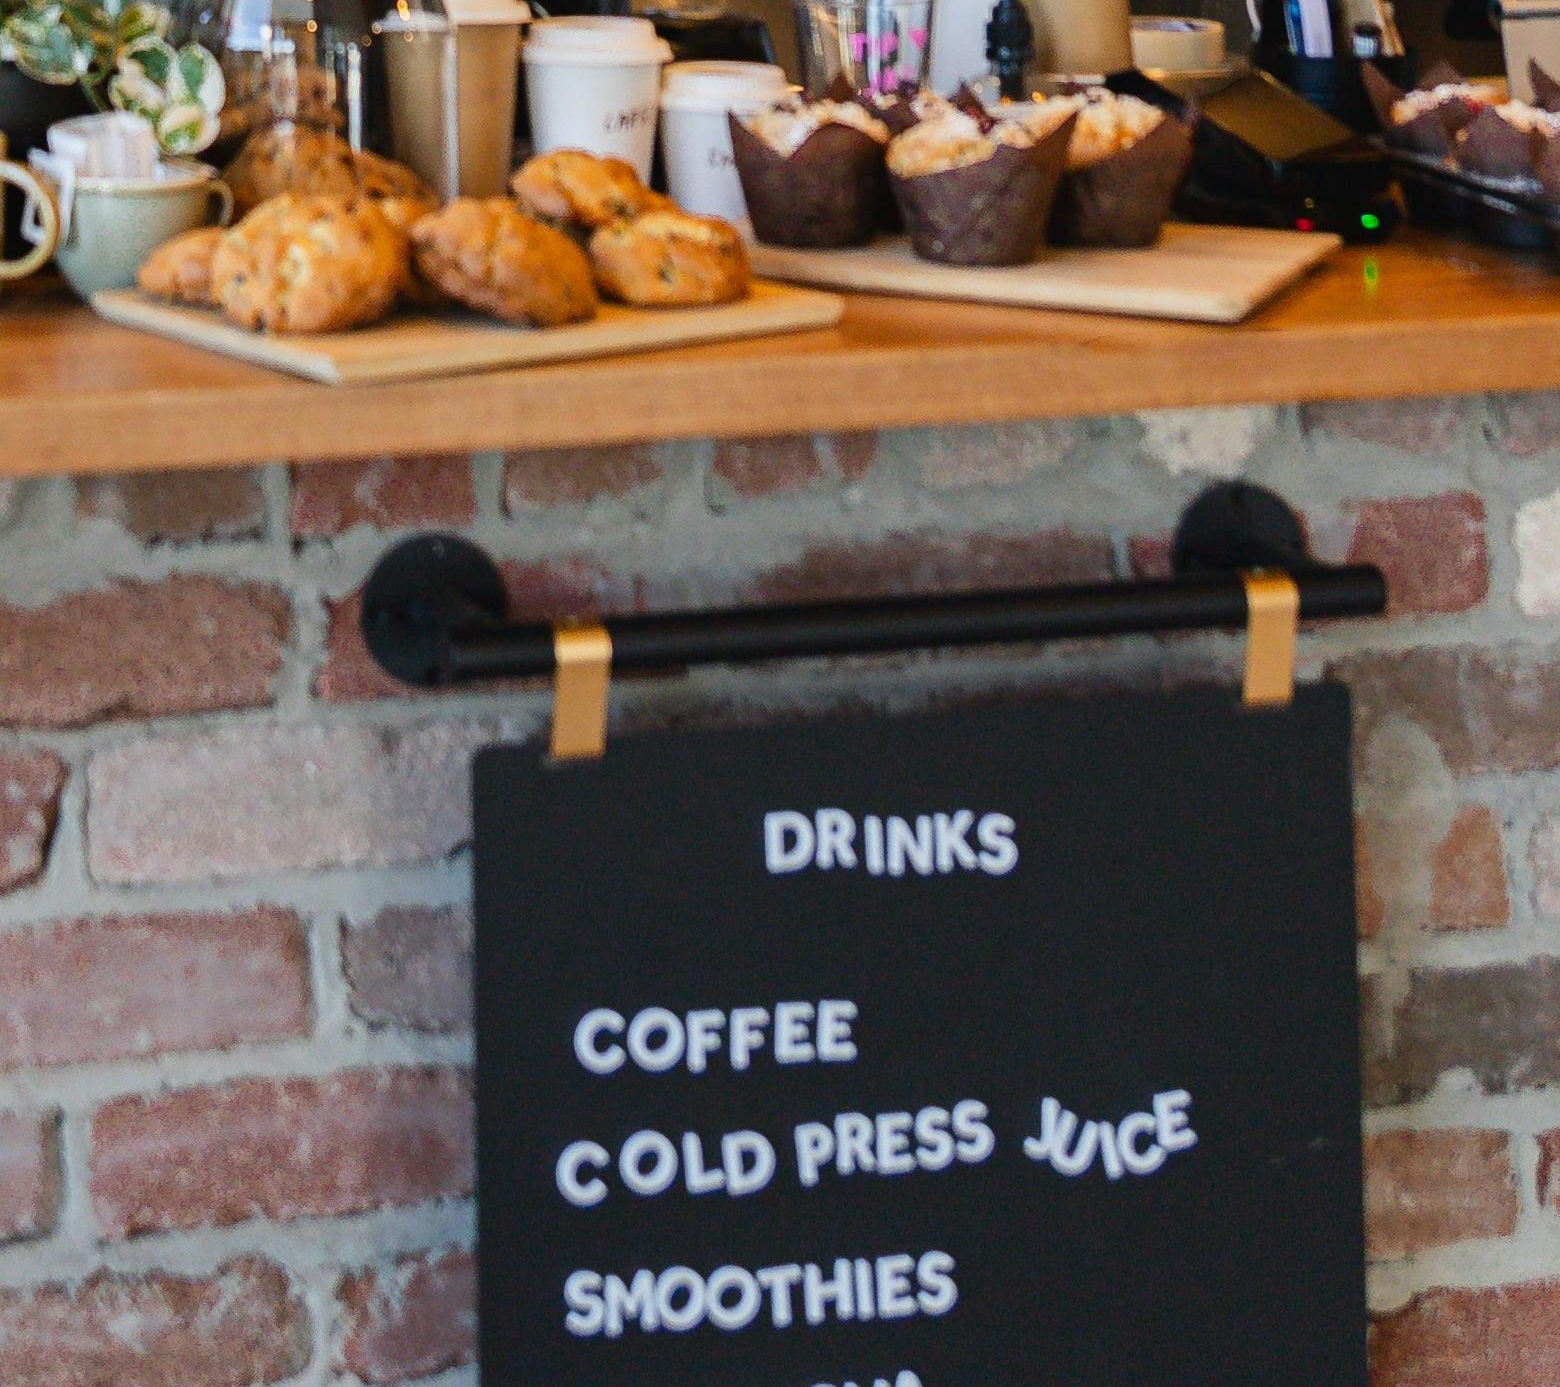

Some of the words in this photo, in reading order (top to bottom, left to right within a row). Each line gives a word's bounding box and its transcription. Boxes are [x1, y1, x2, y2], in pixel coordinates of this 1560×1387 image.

[764, 808, 1018, 876] DRINKS
[574, 1000, 857, 1073] COFFEE
[556, 1130, 775, 1205] COLD
[794, 1099, 995, 1185] PRESS
[1023, 1089, 1197, 1178] JUICE
[564, 1250, 957, 1336] SMOOTHIES
